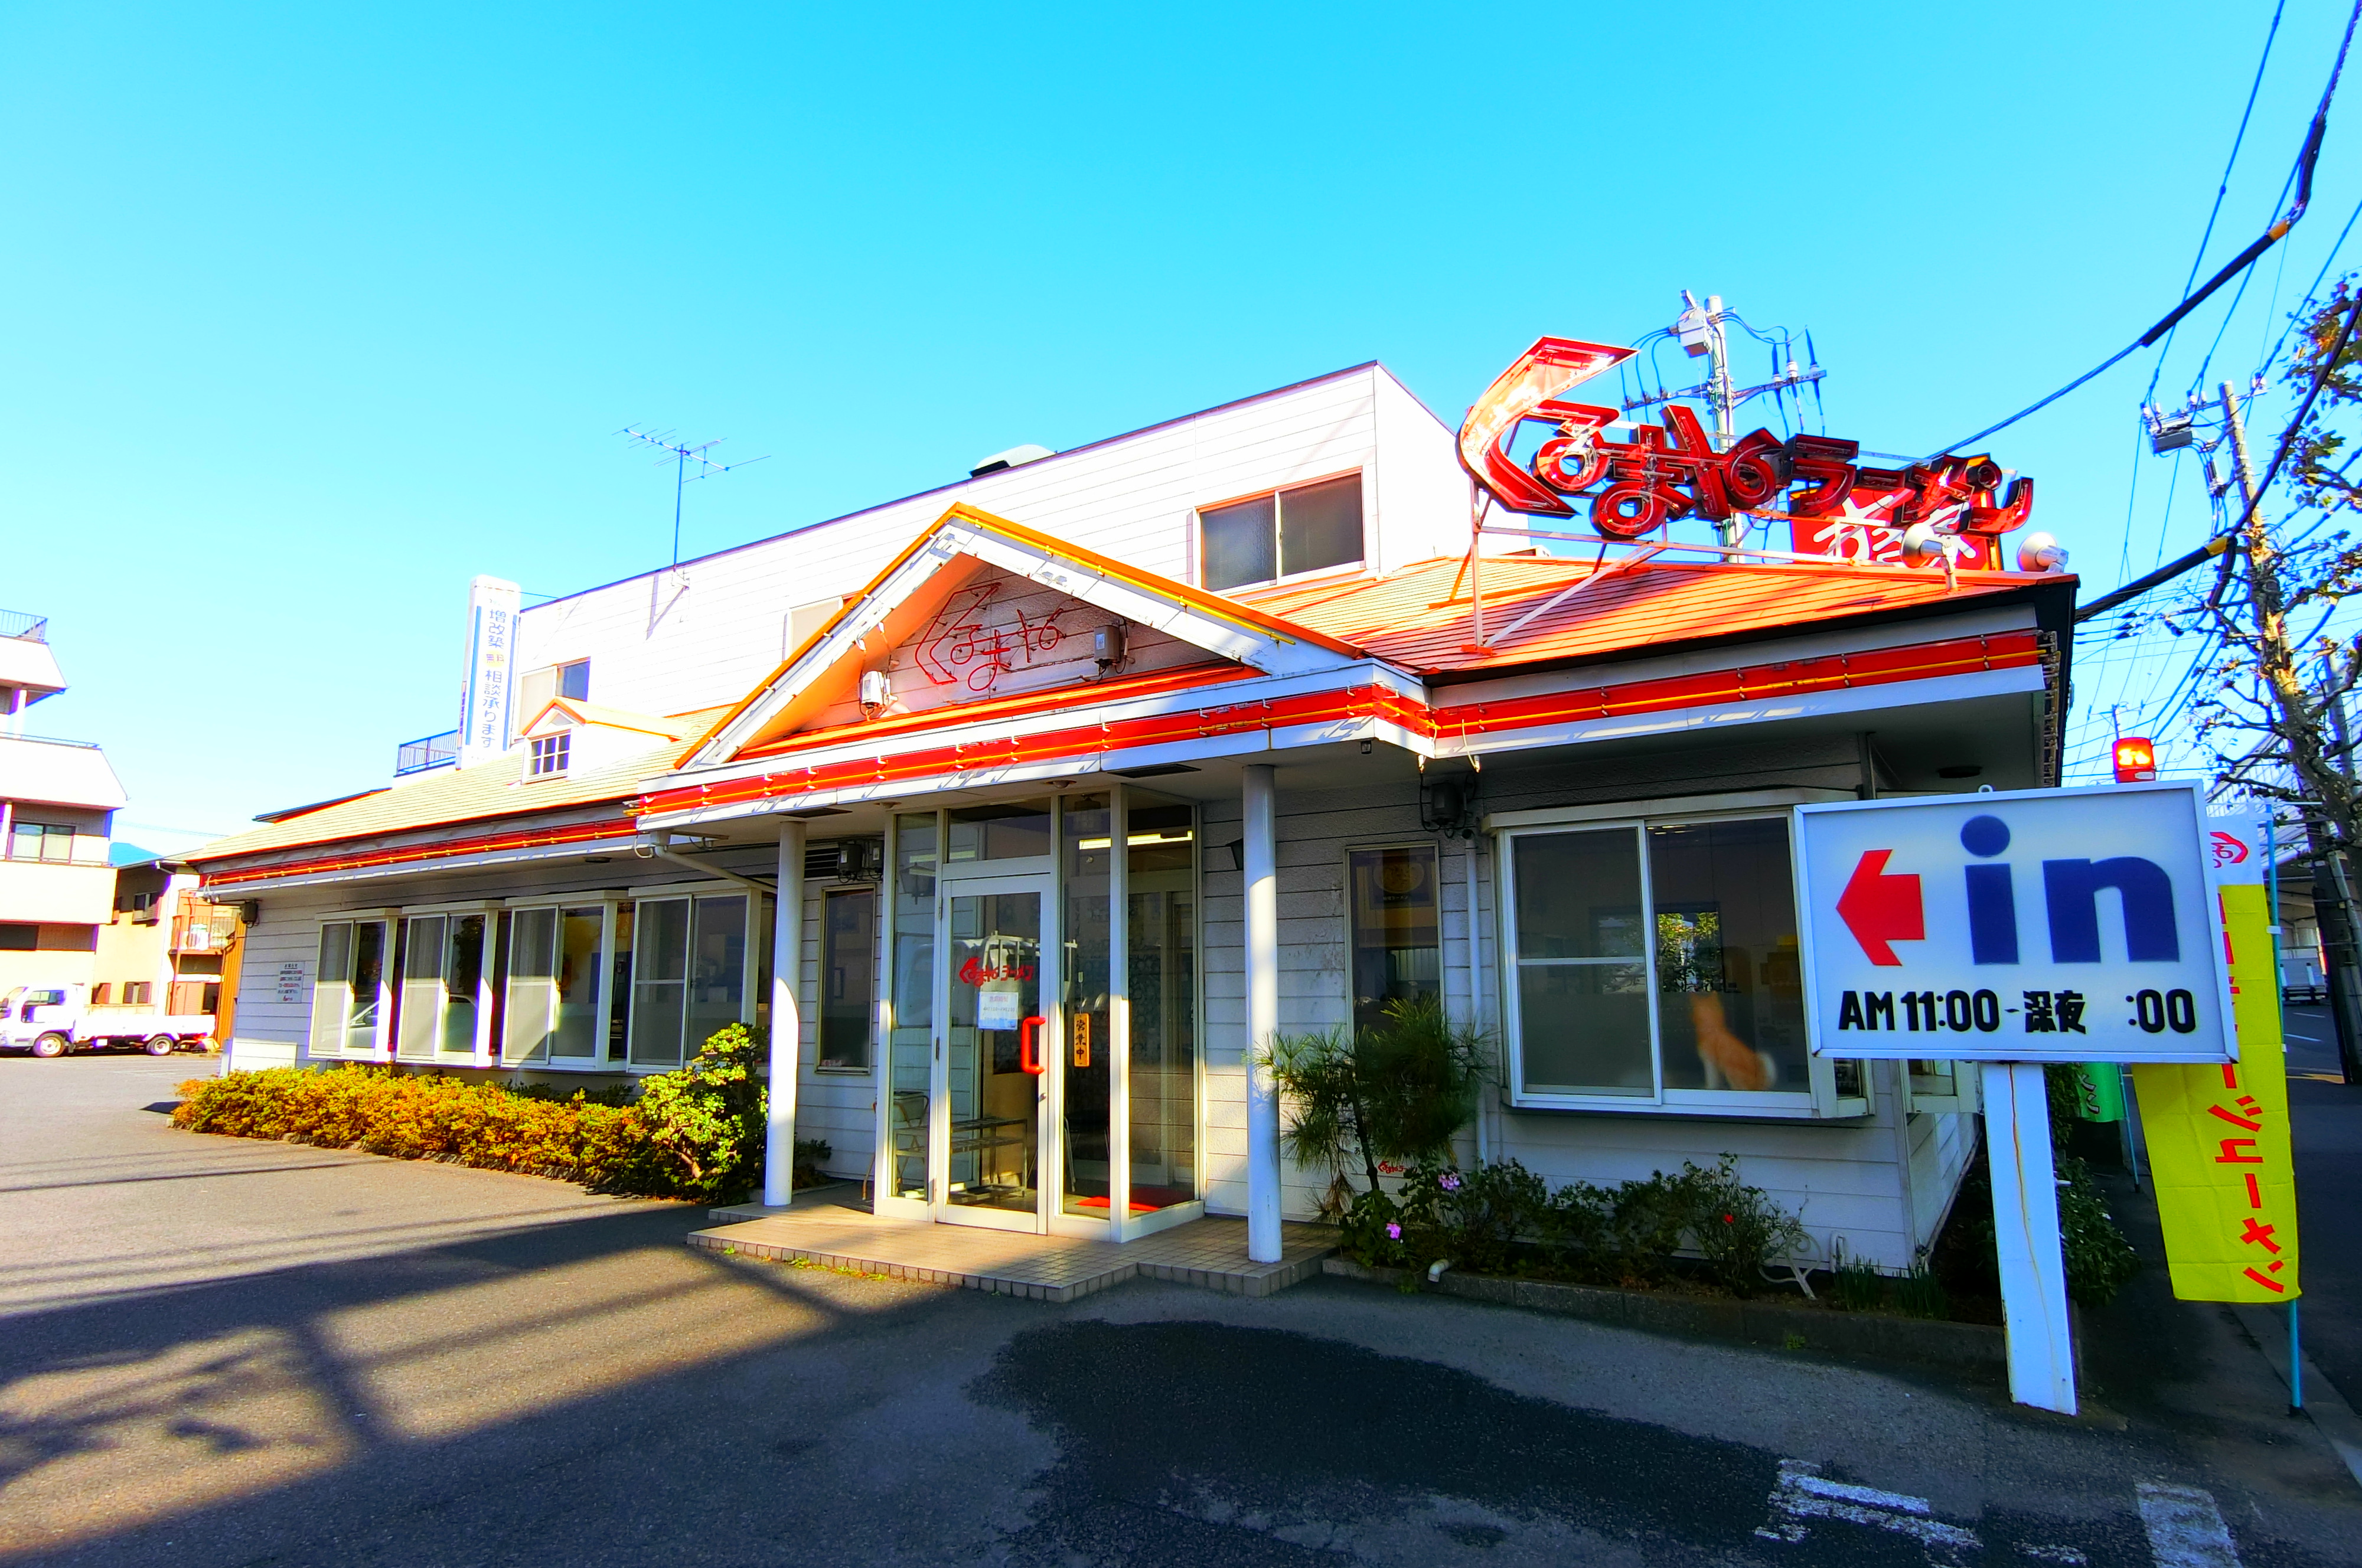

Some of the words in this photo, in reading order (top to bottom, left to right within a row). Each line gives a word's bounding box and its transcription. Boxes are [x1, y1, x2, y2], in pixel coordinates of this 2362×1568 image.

[488, 608, 507, 649] 増改築
[915, 582, 1063, 692] くるまや
[481, 669, 503, 749] 相談承ります
[1960, 815, 2180, 966] in
[1075, 1019, 1087, 1060] 営業中
